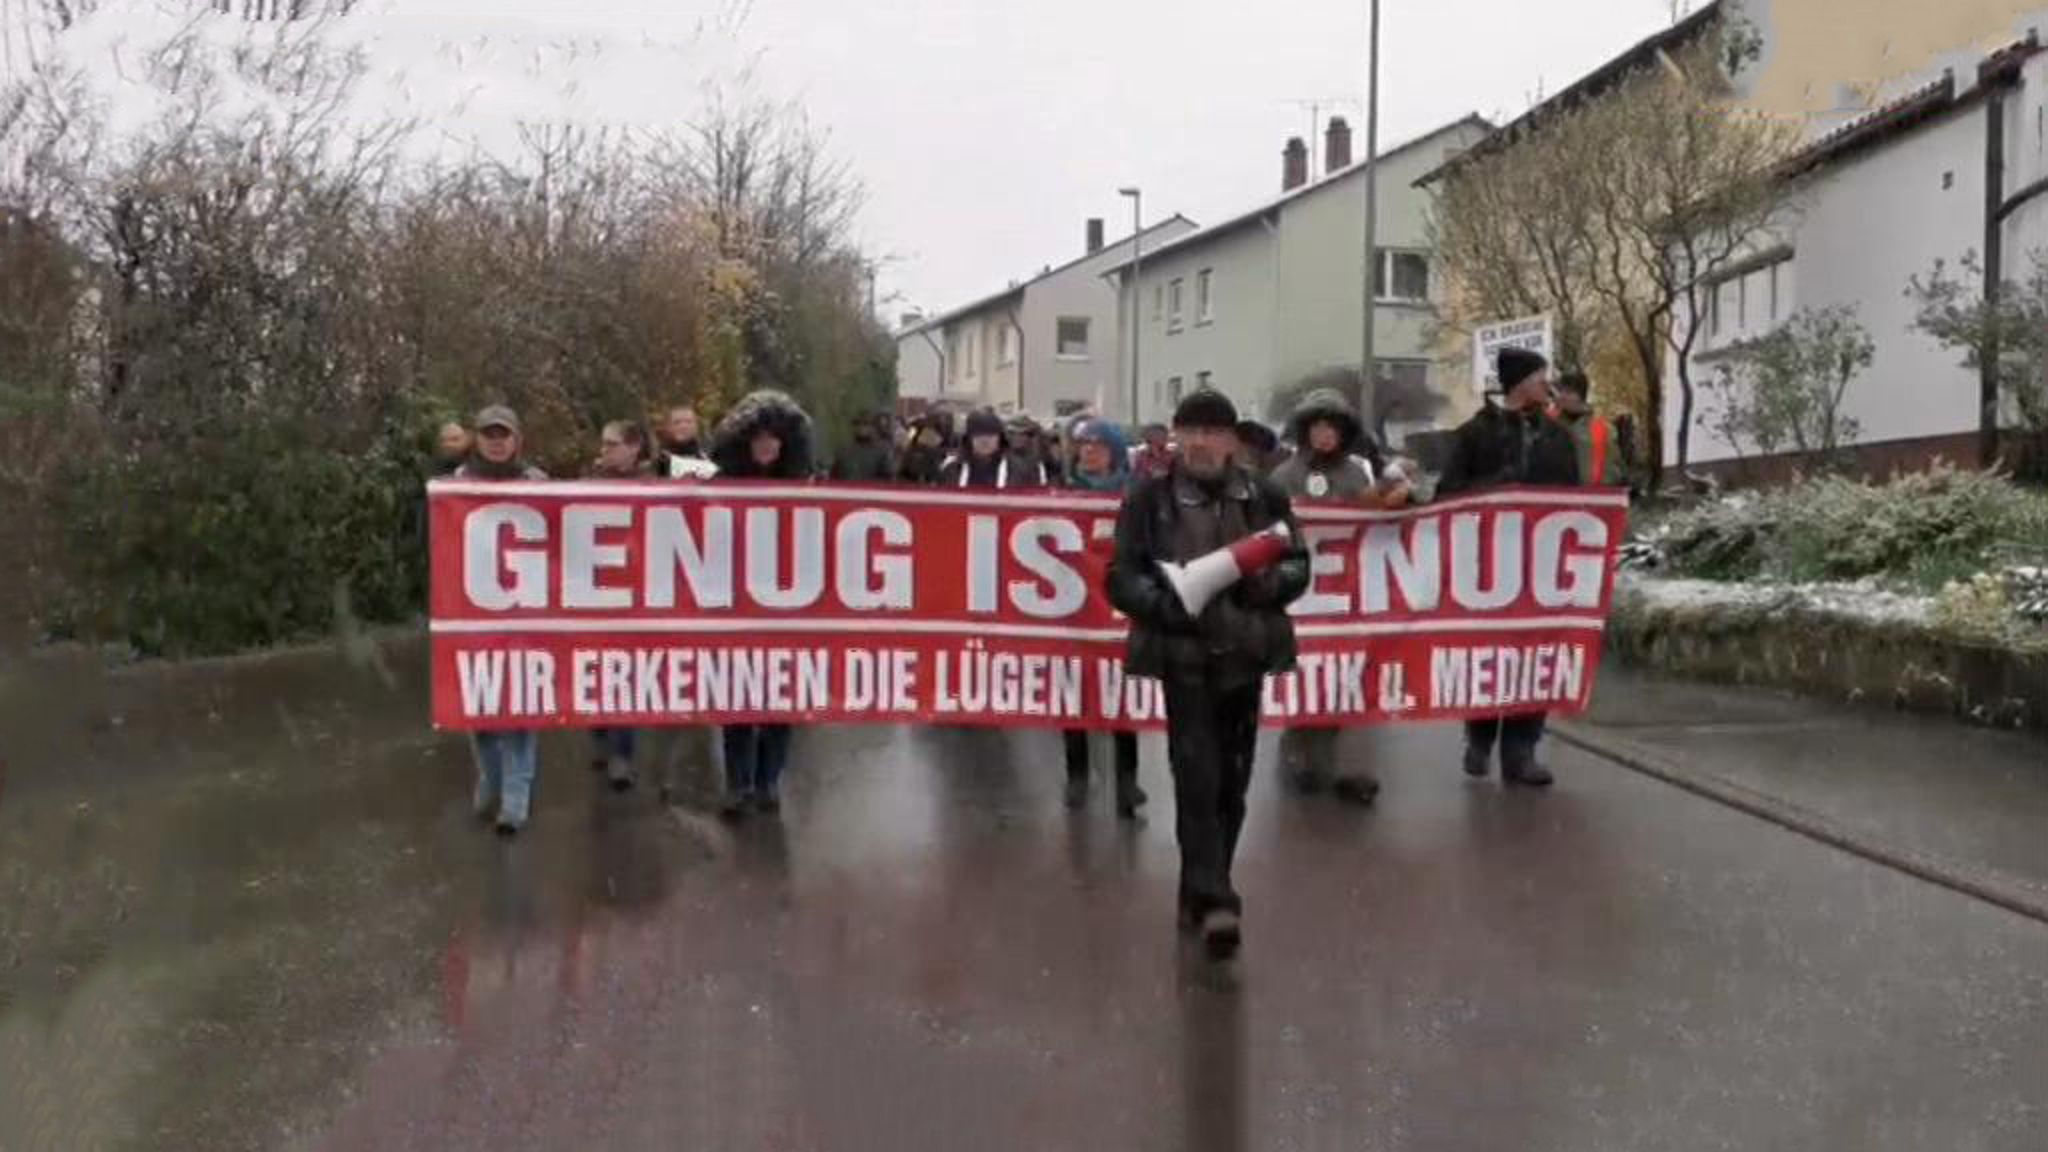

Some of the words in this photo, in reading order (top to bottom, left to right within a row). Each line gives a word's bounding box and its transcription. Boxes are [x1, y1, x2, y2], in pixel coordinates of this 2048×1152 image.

[462, 504, 914, 612] GENUG
[966, 515, 1124, 618] IS
[1285, 508, 1608, 616] ENUG
[456, 649, 557, 718] WIR
[573, 648, 829, 716] ERKENNEN
[843, 648, 918, 713] DIE
[934, 638, 1082, 717] LÜGEN
[1097, 657, 1168, 720] VO
[1261, 651, 1366, 717] LITIK
[1429, 644, 1584, 709] MEDIEN
